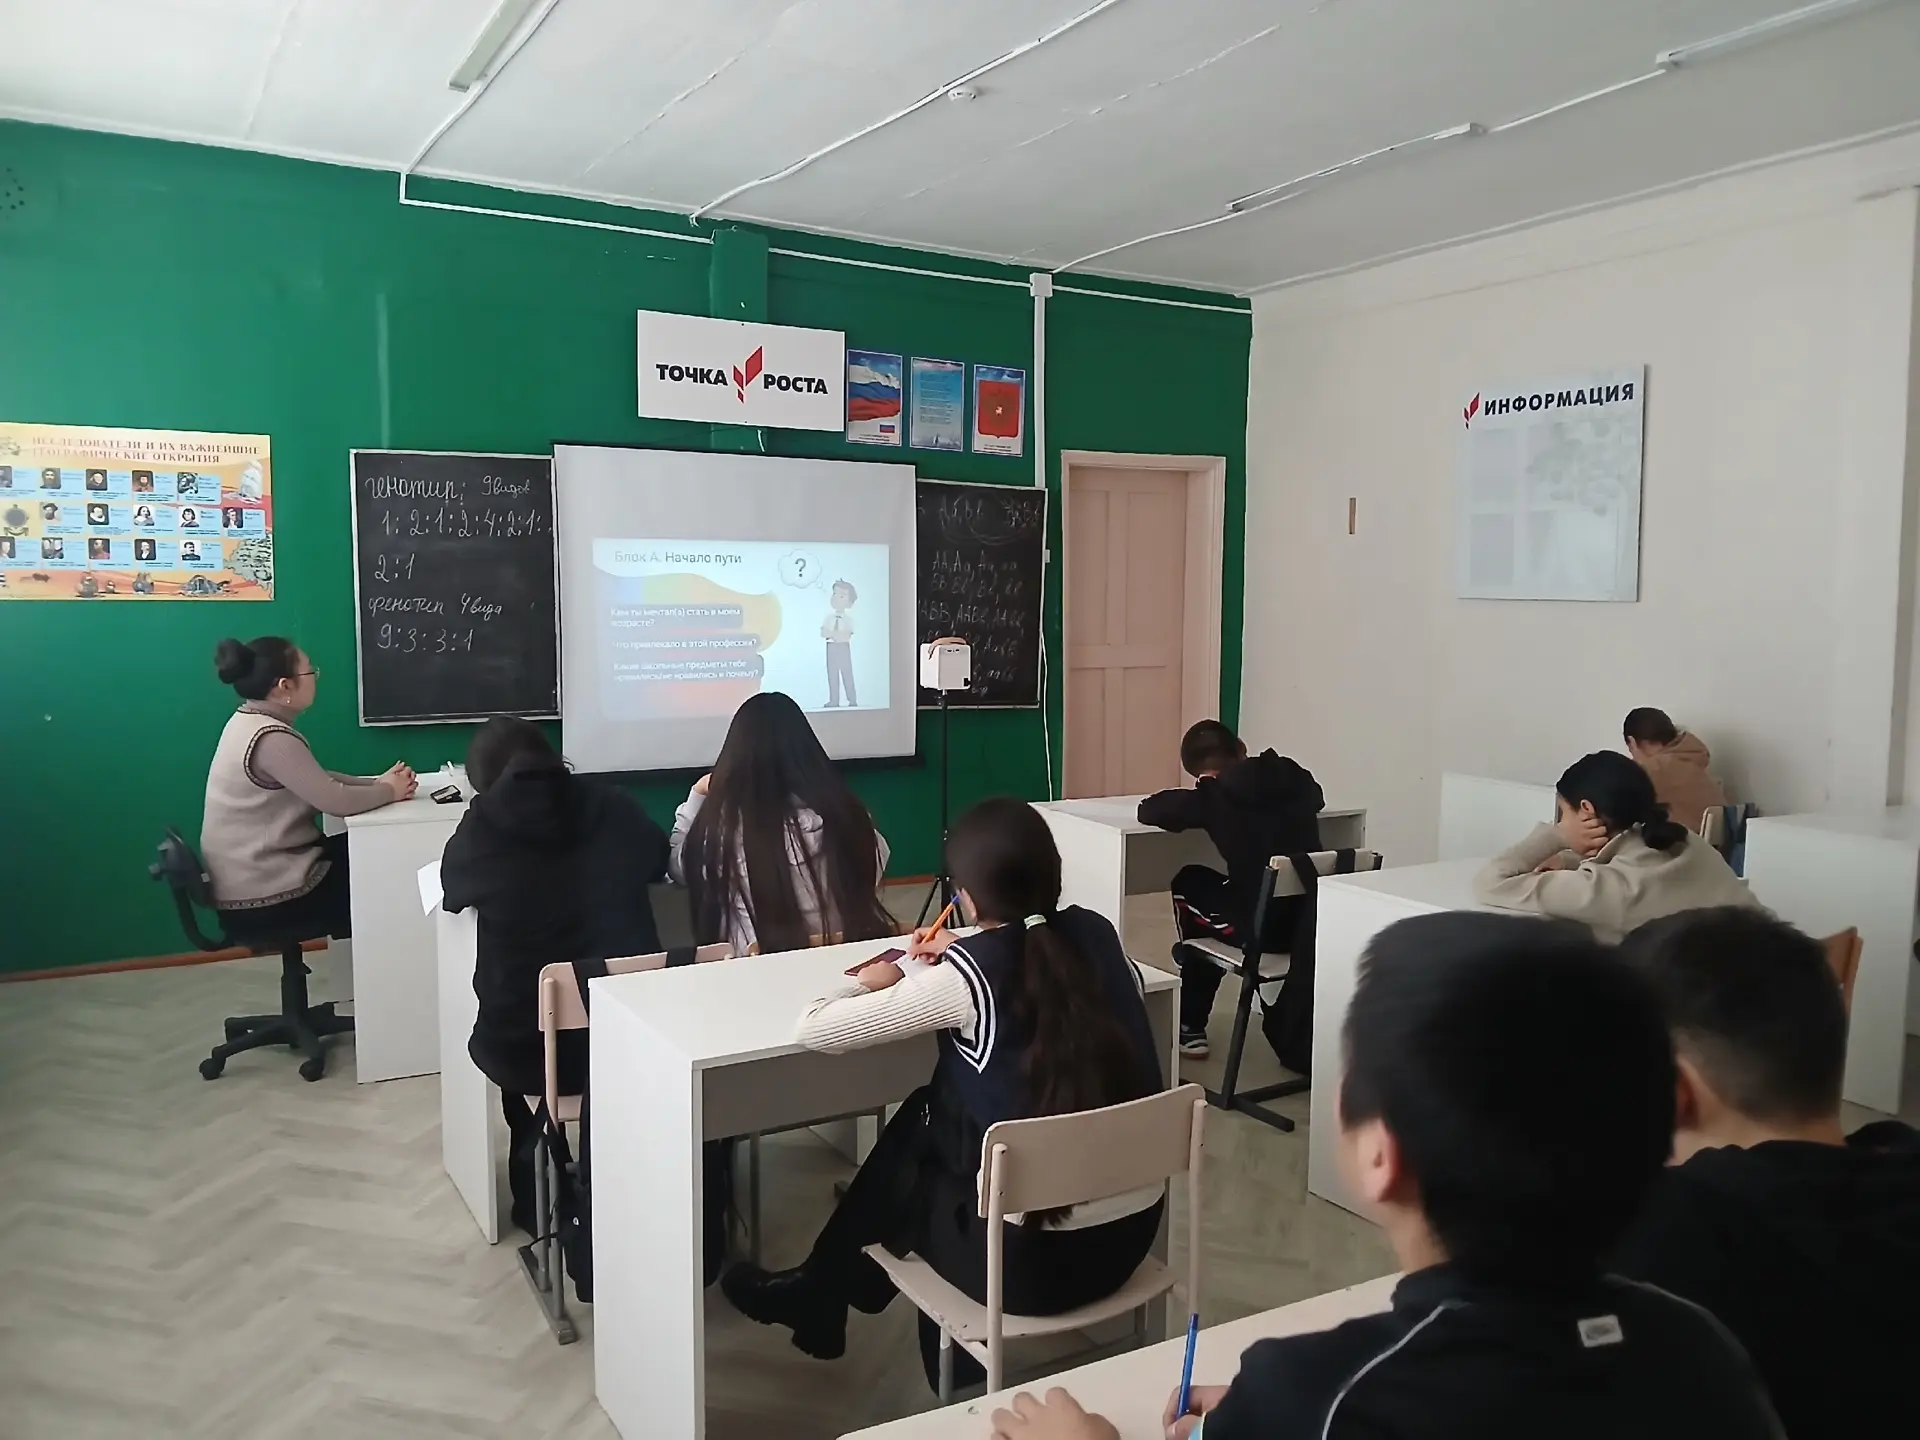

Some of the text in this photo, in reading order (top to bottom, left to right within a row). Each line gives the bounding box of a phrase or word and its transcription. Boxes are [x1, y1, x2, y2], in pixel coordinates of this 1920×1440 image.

[656, 364, 828, 394] ТОЧКА РОСТА
[1484, 383, 1635, 416] ИНФОРМАЦИЯ
[146, 441, 155, 451] И
[159, 442, 176, 452] ИХ
[180, 442, 260, 455] ВАЖНЕЙШИЕ
[152, 453, 221, 464] ОТКРЫТИЯ
[614, 550, 648, 563] Блок
[665, 552, 711, 564] Начало
[714, 554, 742, 567] пути
[689, 639, 708, 648] этой
[709, 638, 757, 650] профессии?
